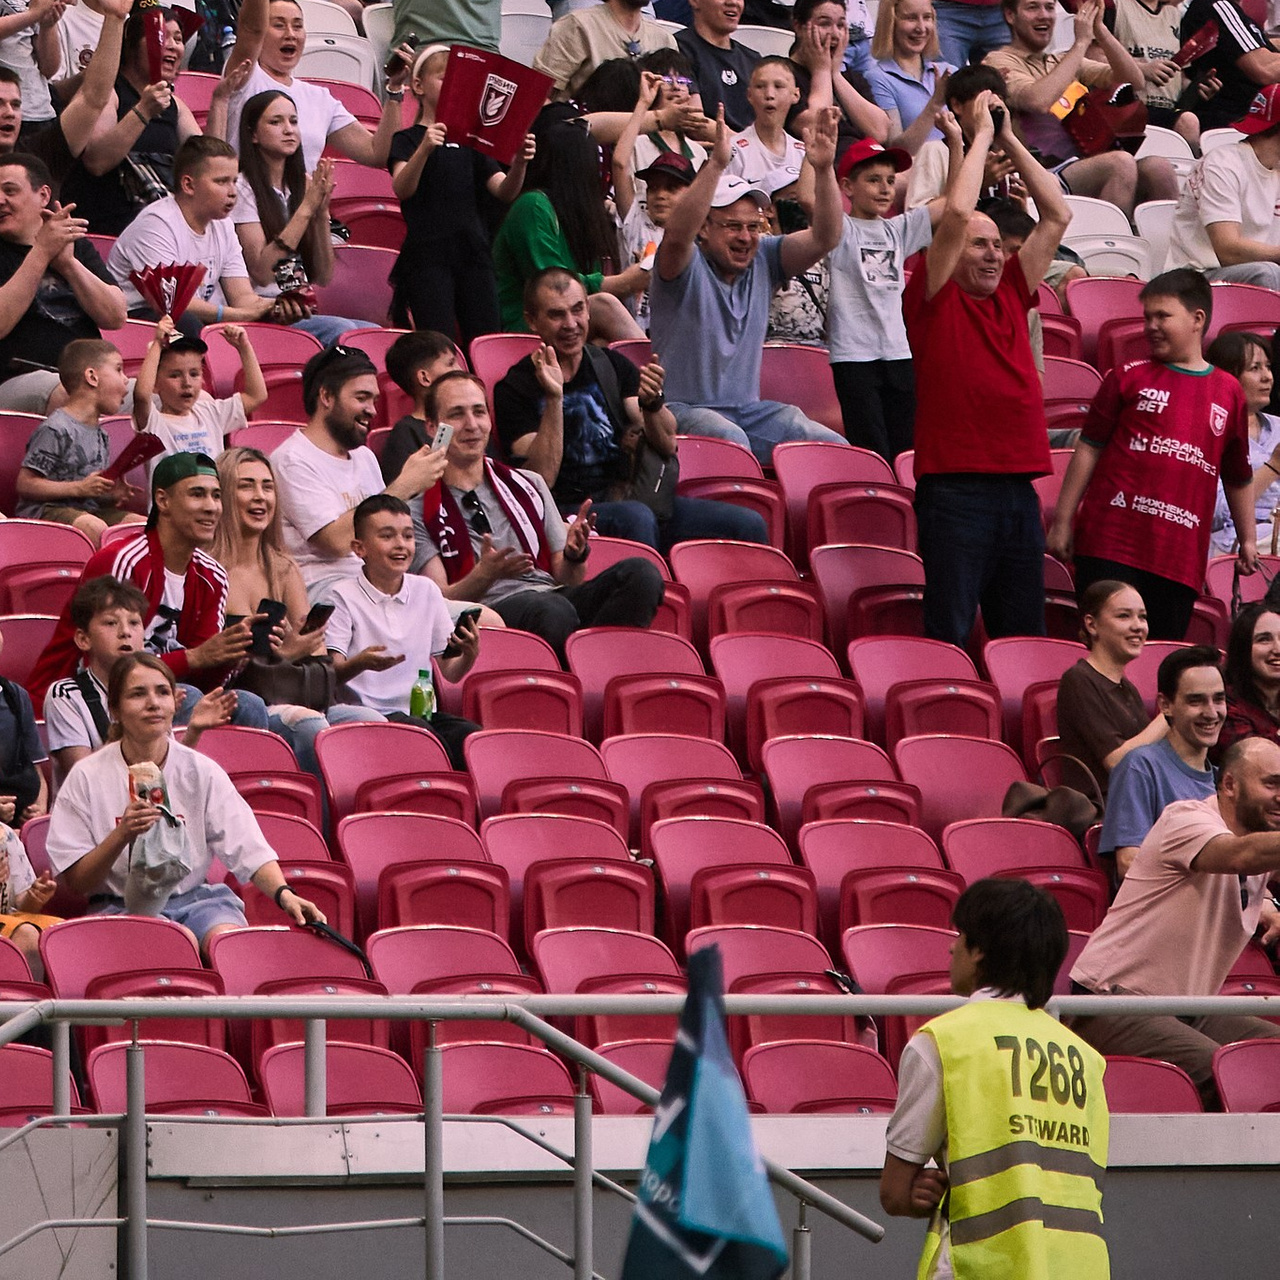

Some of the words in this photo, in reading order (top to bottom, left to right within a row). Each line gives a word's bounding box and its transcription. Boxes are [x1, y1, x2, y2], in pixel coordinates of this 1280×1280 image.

[487, 75, 518, 93] РУБИН
[1137, 400, 1170, 416] BET
[1150, 442, 1217, 477] ОРГСИНТЕЗ
[1151, 434, 1205, 459] КАЗАНЬ
[1131, 503, 1195, 530] НЕФТЕХИМ
[994, 1035, 1088, 1110] 7268
